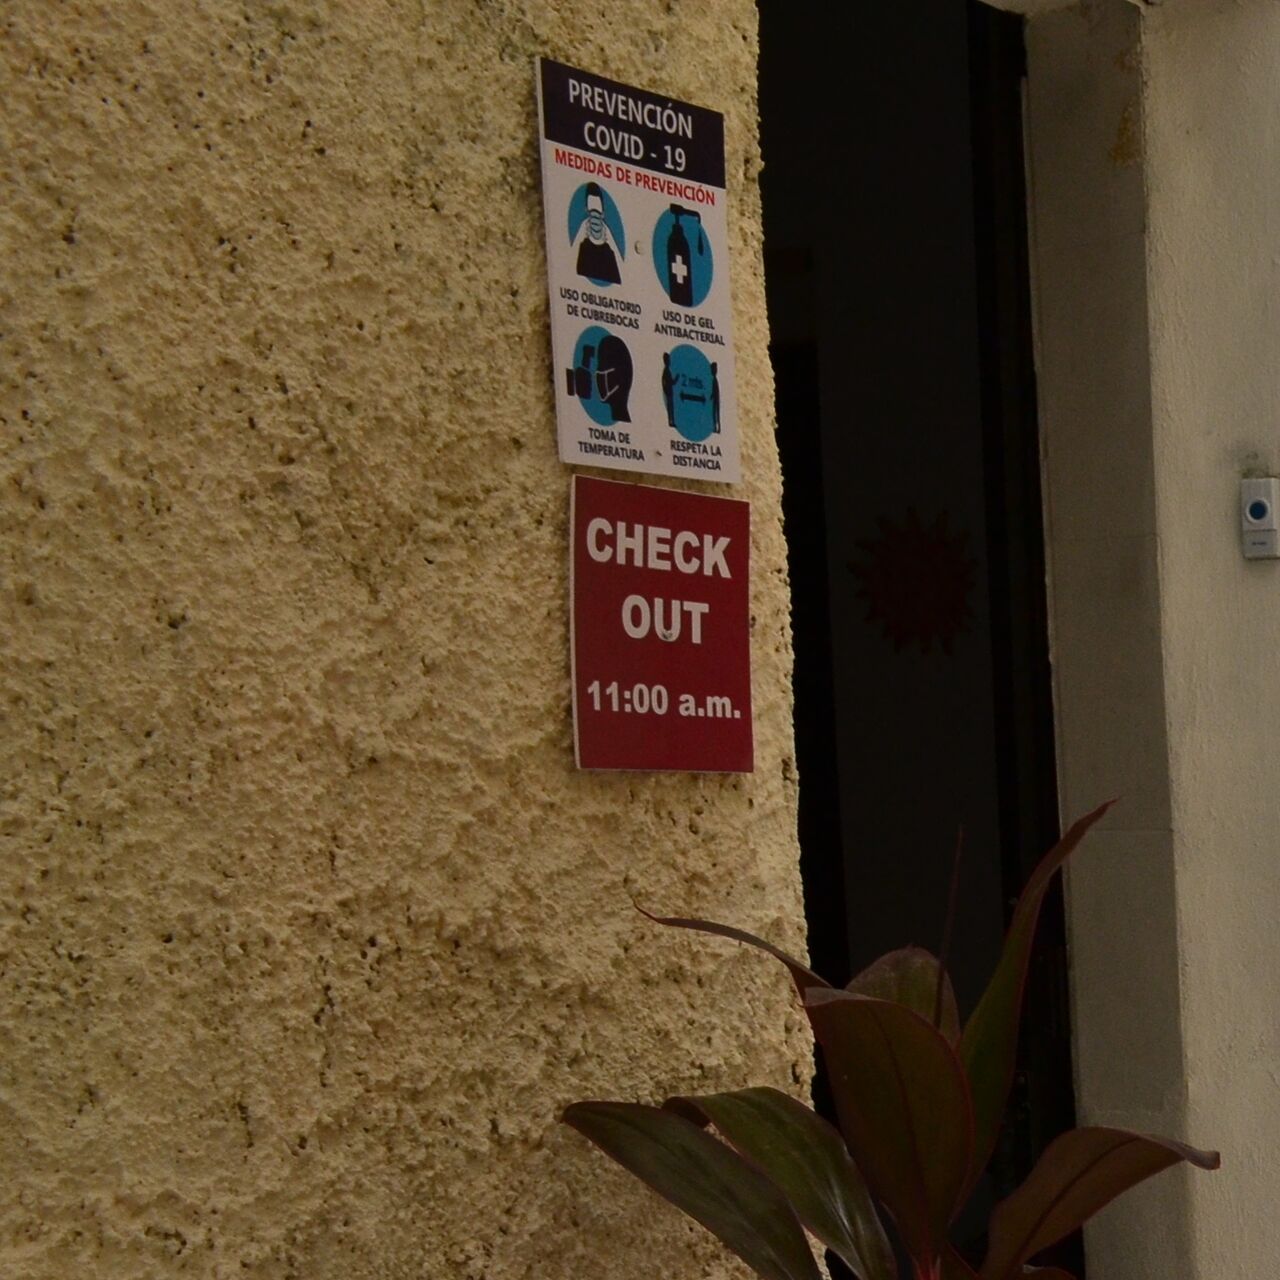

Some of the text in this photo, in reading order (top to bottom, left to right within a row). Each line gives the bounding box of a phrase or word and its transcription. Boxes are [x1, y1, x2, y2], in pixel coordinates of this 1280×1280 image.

[567, 78, 693, 139] PREVENCIÓN
[583, 121, 644, 161] COVID
[664, 145, 687, 172] 19
[555, 148, 716, 206] MEDIDAS DE PREVENCIÓN
[559, 286, 642, 316] USO OBLIGATORIO
[566, 303, 640, 330] DE CUBREBOCAS
[662, 309, 716, 331] USO DE GEL
[654, 322, 726, 347] ANTIBACTERIAL
[588, 426, 631, 445] TOMA DE
[670, 439, 722, 458] RESPETA LA
[577, 440, 646, 462] TEMPERATURA
[672, 454, 722, 471] DISTANCIA
[586, 517, 732, 580] CHECK
[621, 593, 710, 645] OUT
[587, 679, 742, 720] 11:00 a.m.
